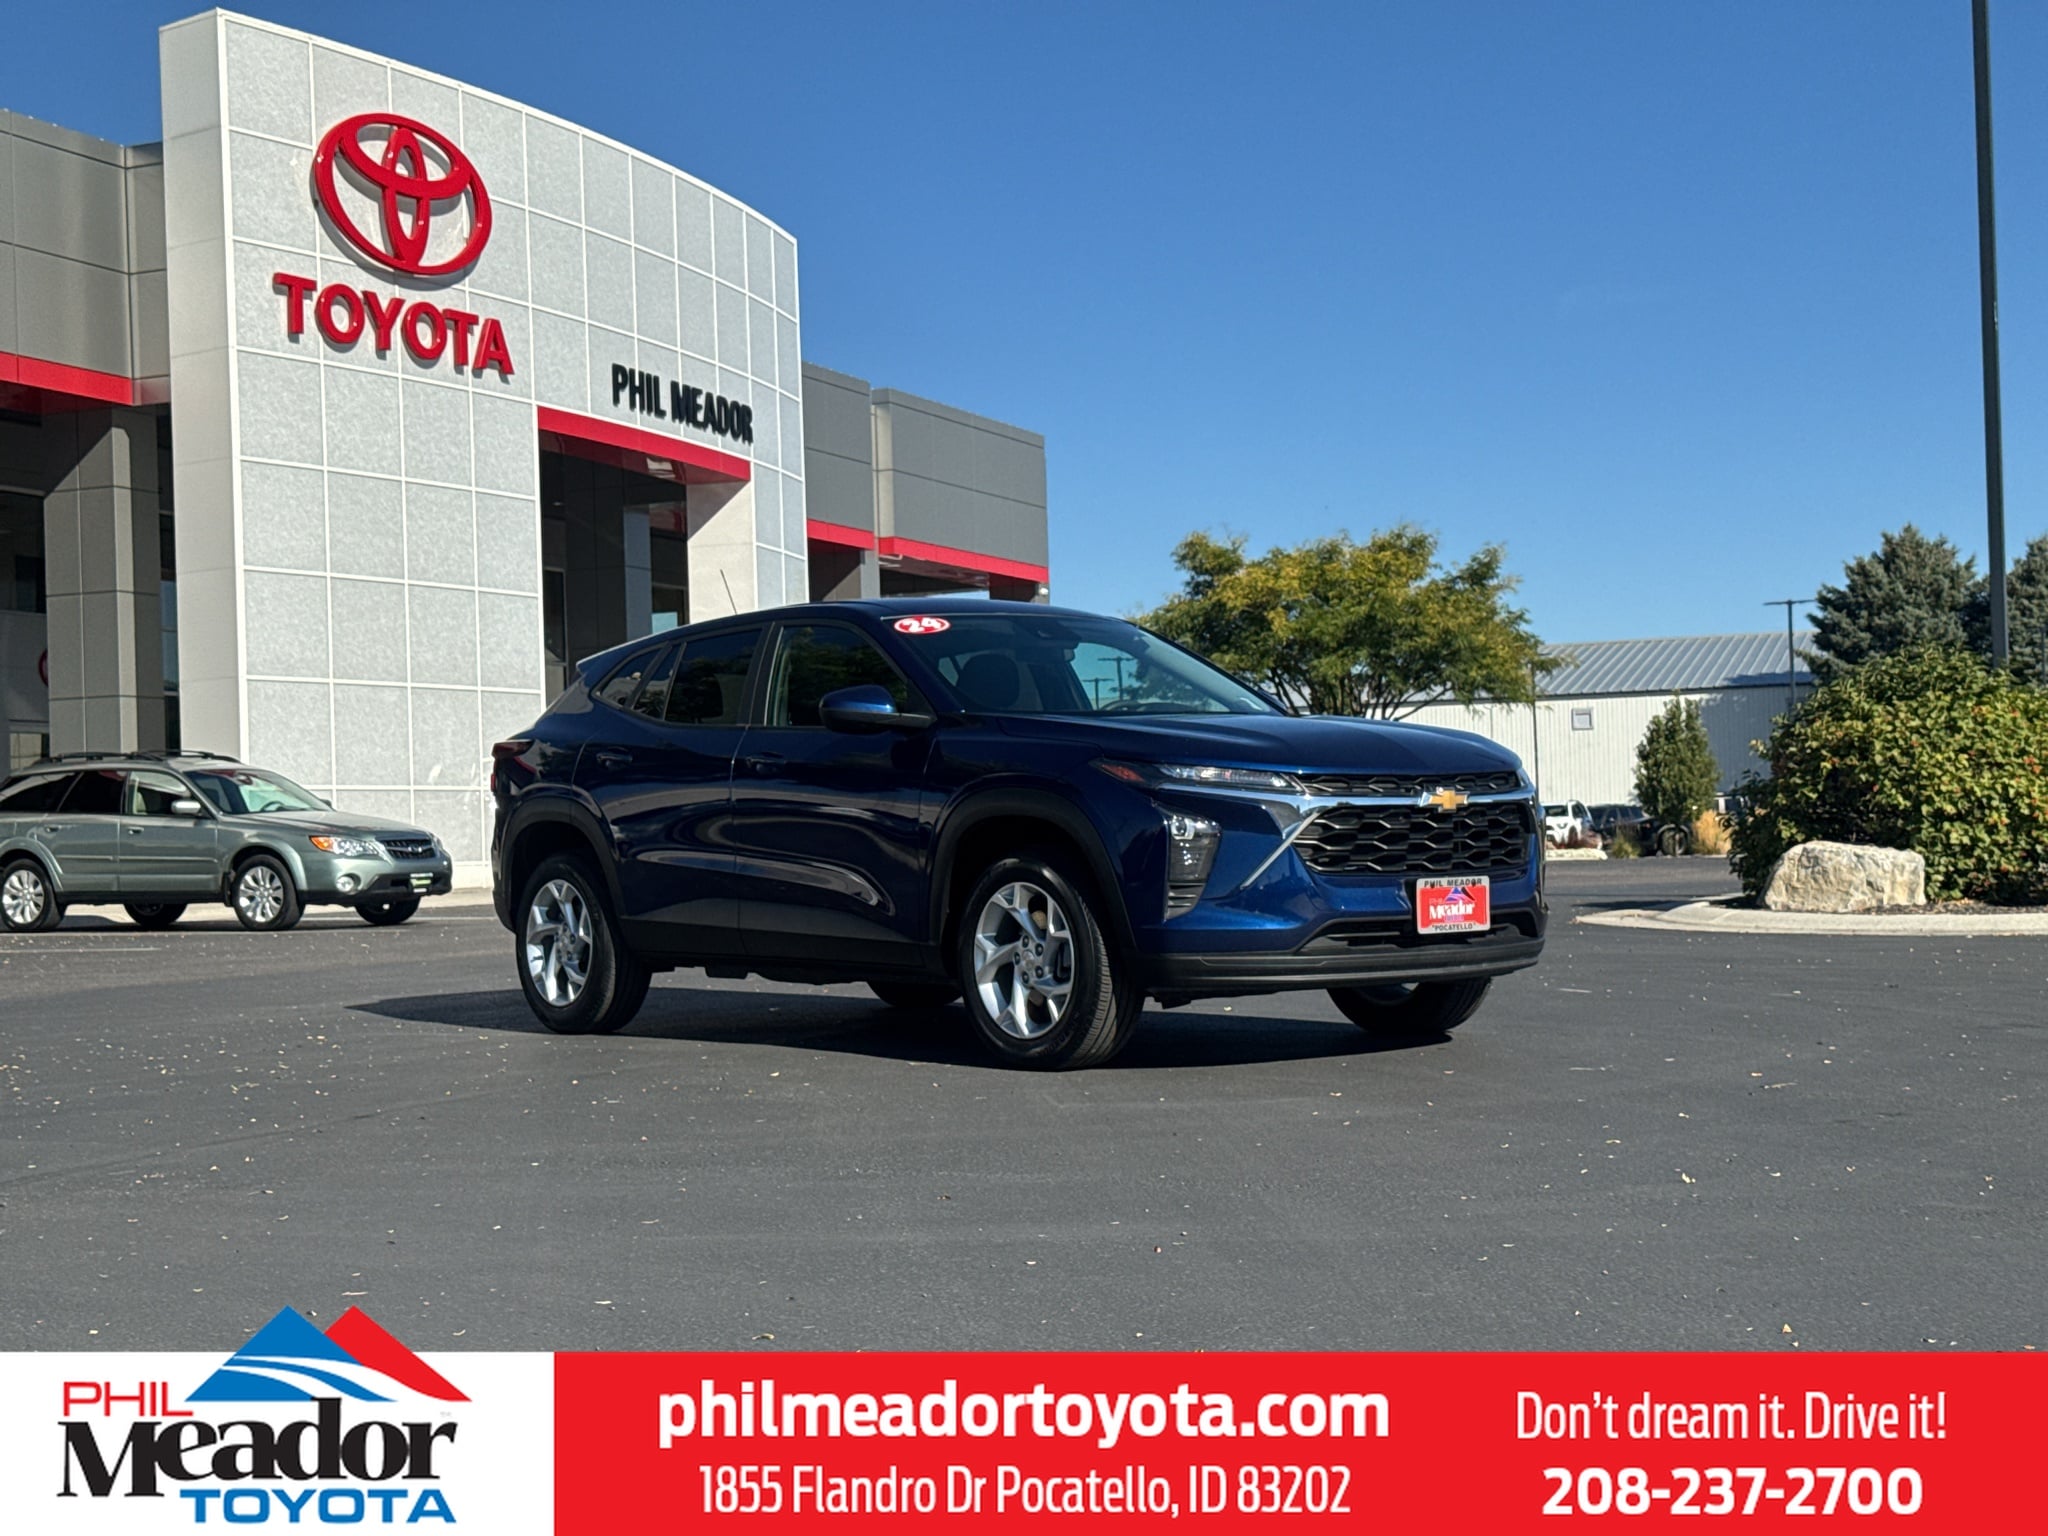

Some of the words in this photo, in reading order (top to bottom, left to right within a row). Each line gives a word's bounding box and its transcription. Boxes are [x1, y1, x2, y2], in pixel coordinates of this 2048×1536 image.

[273, 272, 514, 376] TOYOTA
[611, 363, 667, 419] PHIL
[671, 380, 754, 445] MEADOR
[901, 617, 941, 632] 24
[1447, 878, 1482, 887] MEADOR
